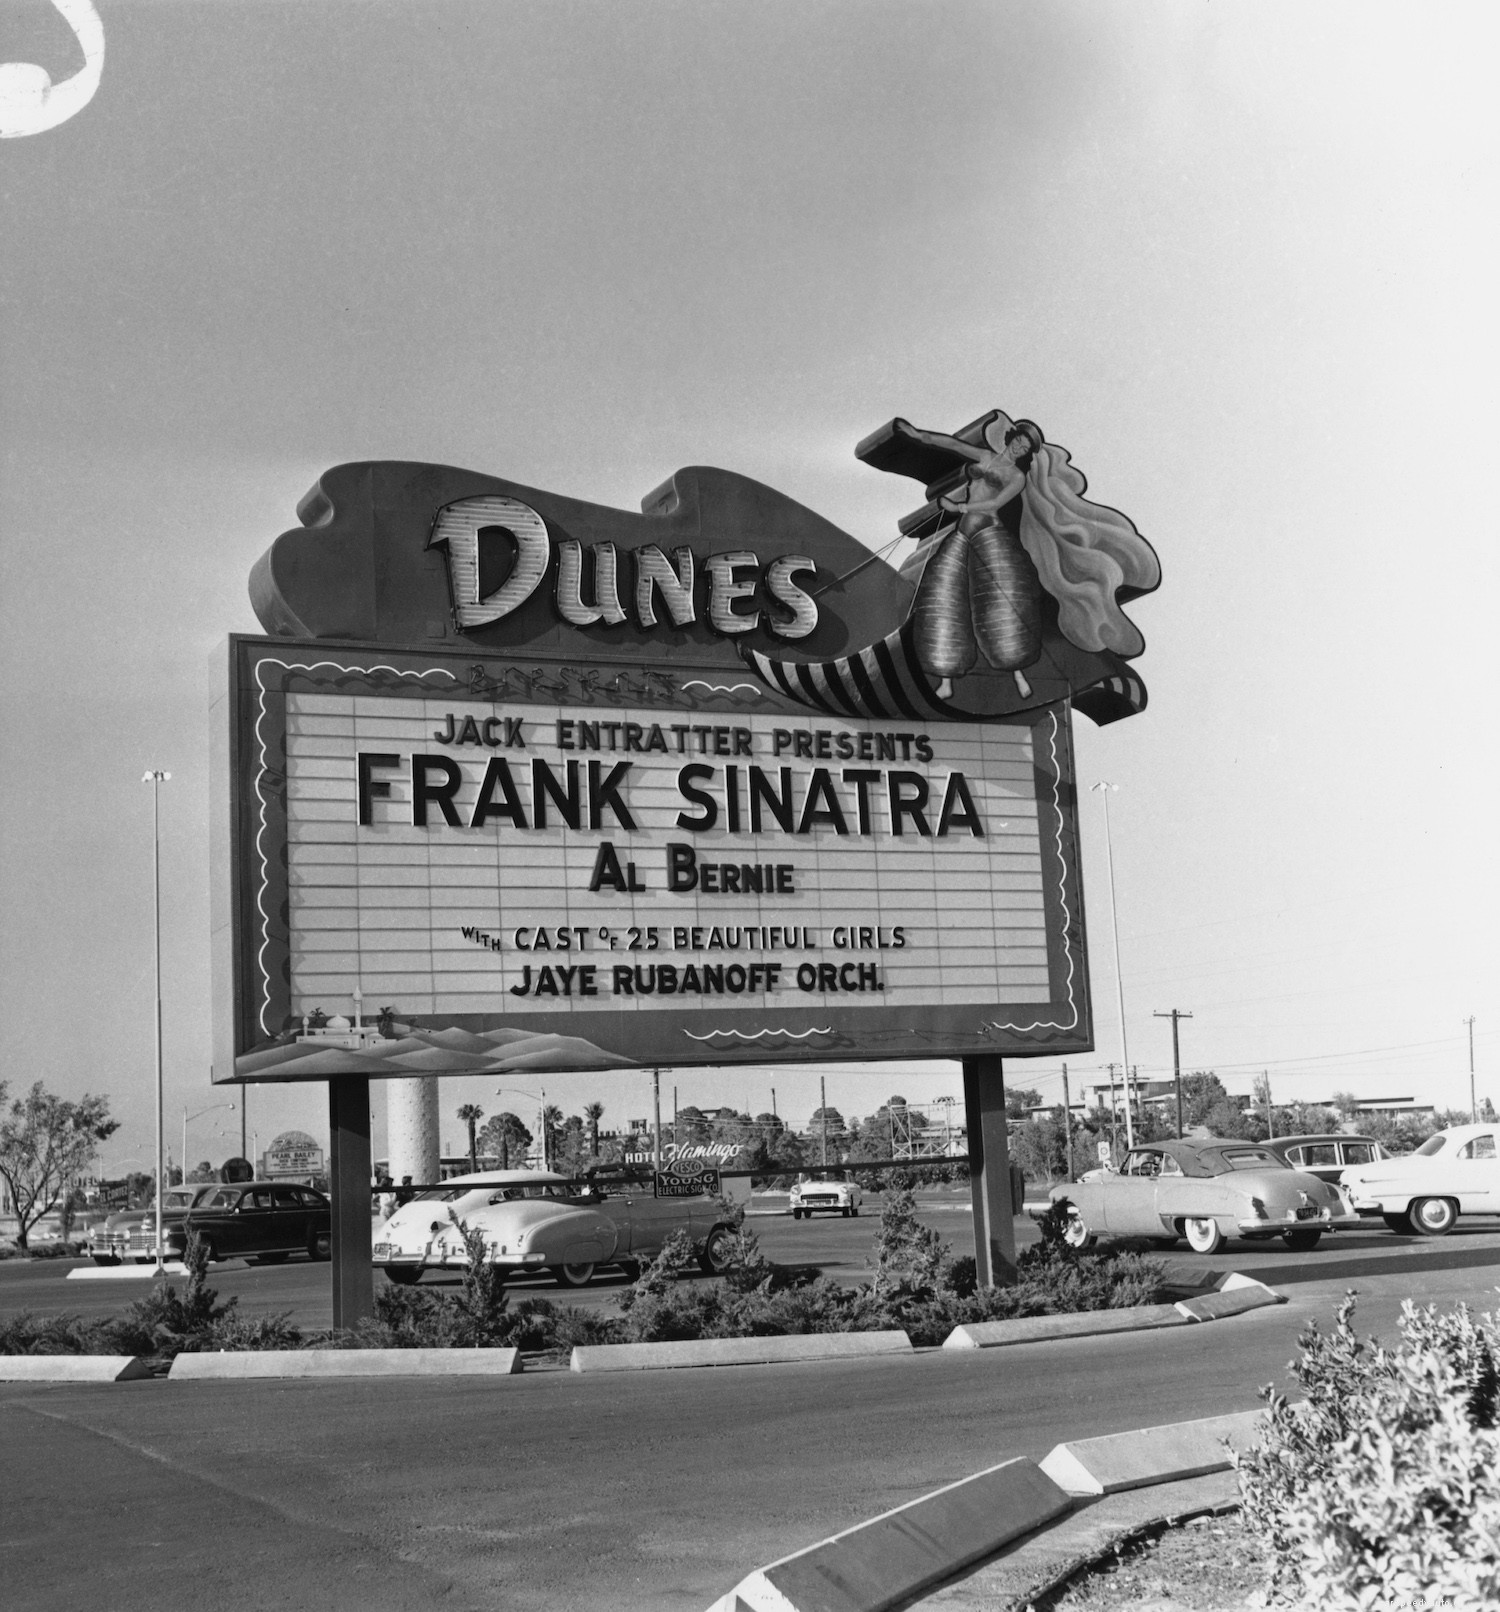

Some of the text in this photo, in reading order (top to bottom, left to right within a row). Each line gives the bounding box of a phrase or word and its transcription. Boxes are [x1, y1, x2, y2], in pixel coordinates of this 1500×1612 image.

[424, 493, 819, 639] DUNES
[433, 713, 934, 763] JACK ENTRATTER PRESENTS
[356, 752, 985, 838] FRANK SINATRA
[588, 841, 795, 894] AL BERNIE
[460, 925, 907, 951] WITH CAST OF 25 BEAUTIFUL GIRLS
[509, 962, 885, 997] JAYE RUBANOFF ORCH.
[663, 1141, 744, 1171] Flamingo
[674, 1161, 700, 1173] YESCO
[658, 1184, 690, 1196] ELECTRIC
[659, 1173, 715, 1186] YOUNG
